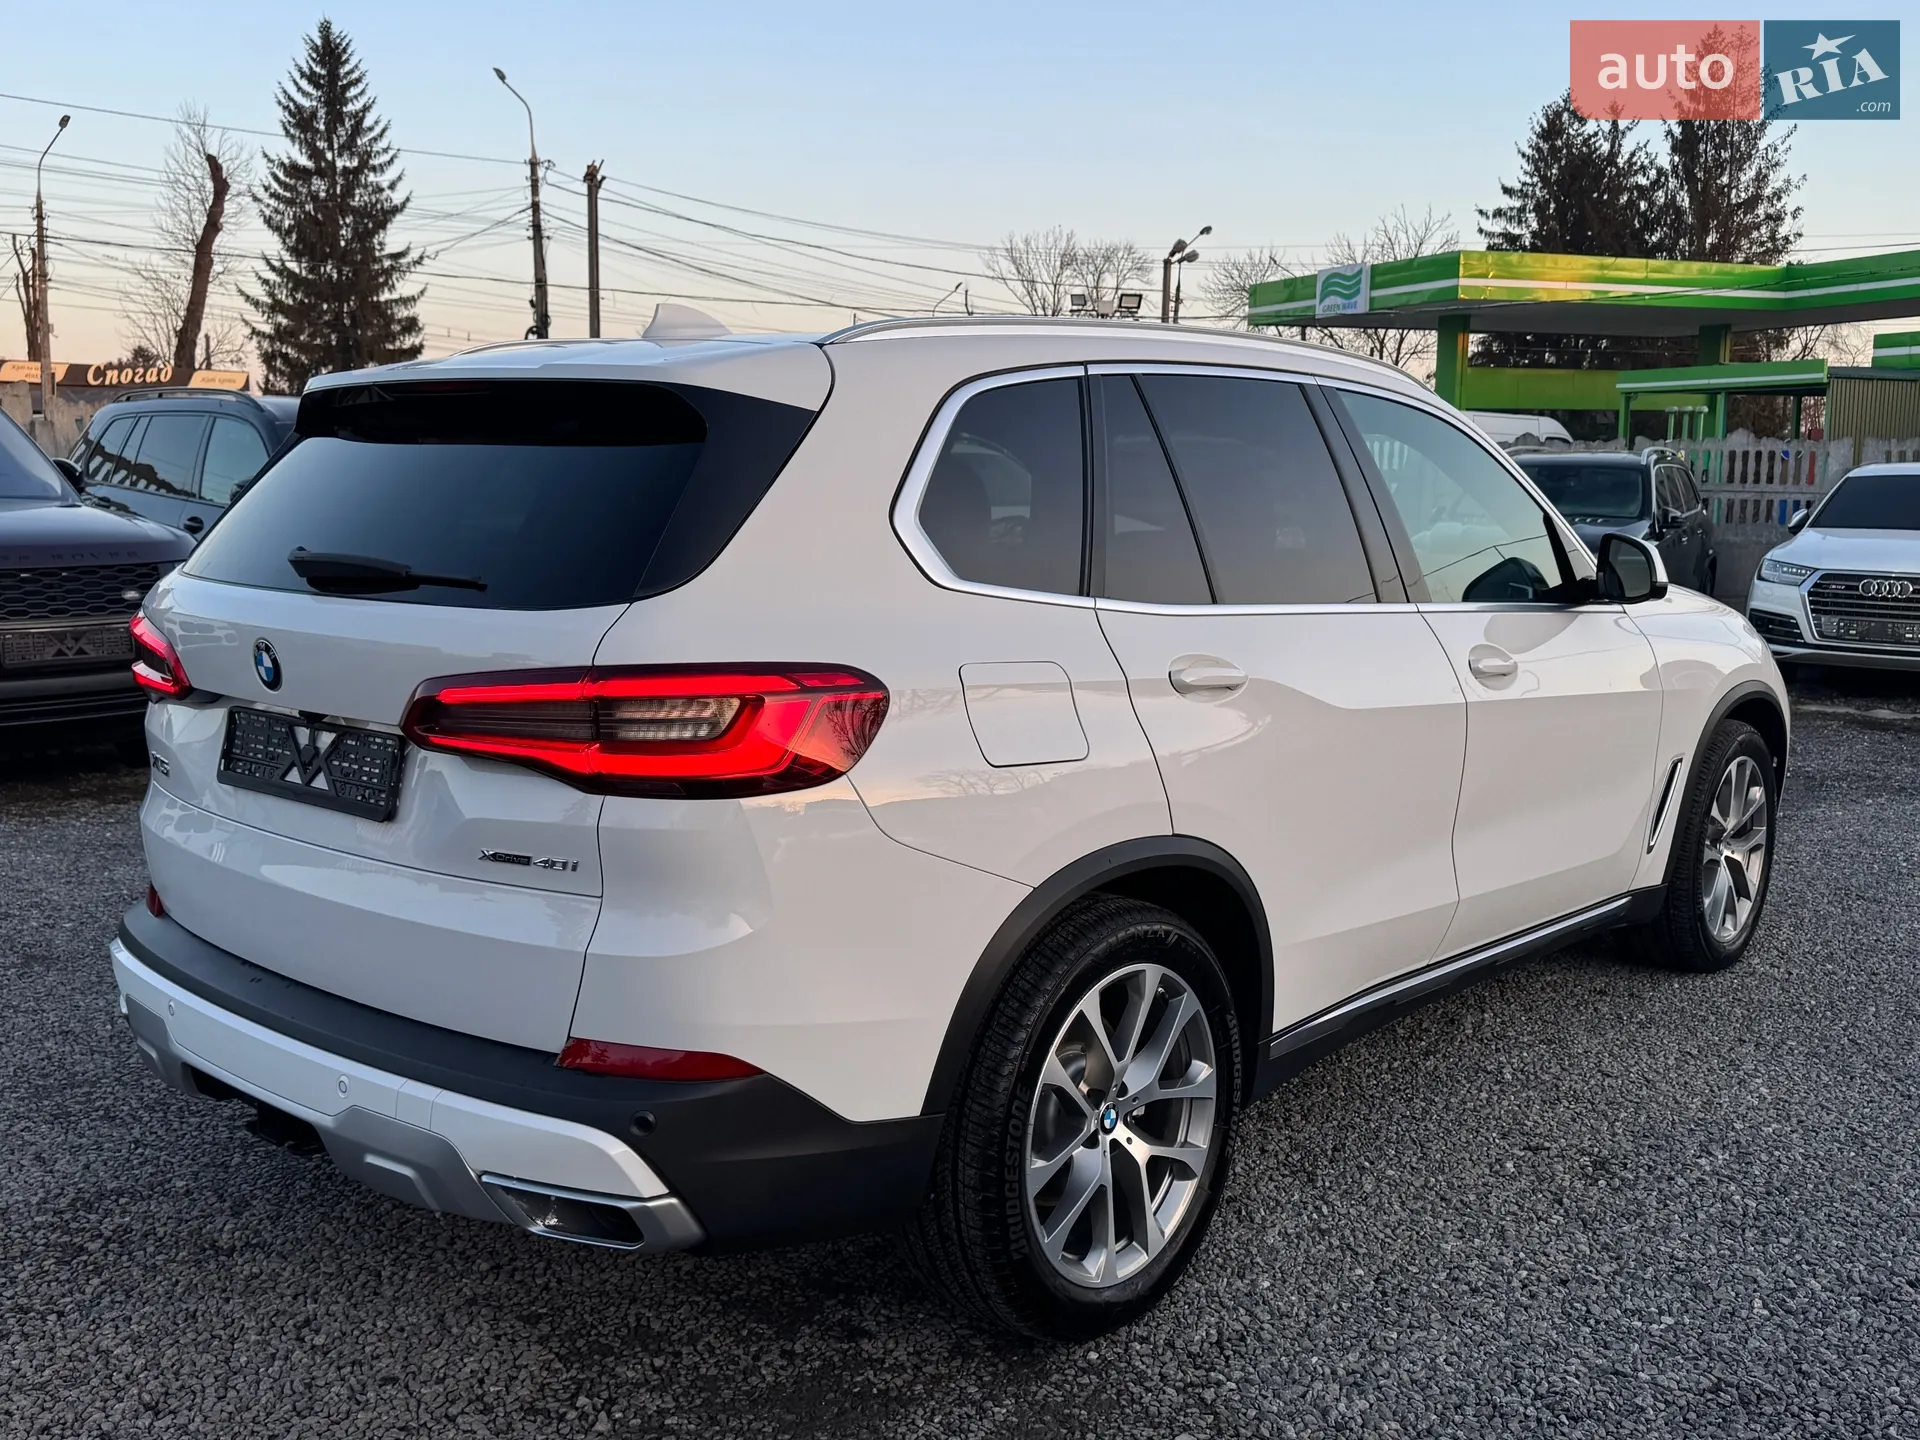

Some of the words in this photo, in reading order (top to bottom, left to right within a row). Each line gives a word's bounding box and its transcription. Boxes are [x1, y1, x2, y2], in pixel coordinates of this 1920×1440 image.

[1322, 303, 1341, 313] GREEN
[1341, 301, 1358, 311] WAVE
[86, 363, 173, 386] Спогад
[151, 750, 171, 777] X5
[1003, 1080, 1031, 1260] BRIDGESTONE
